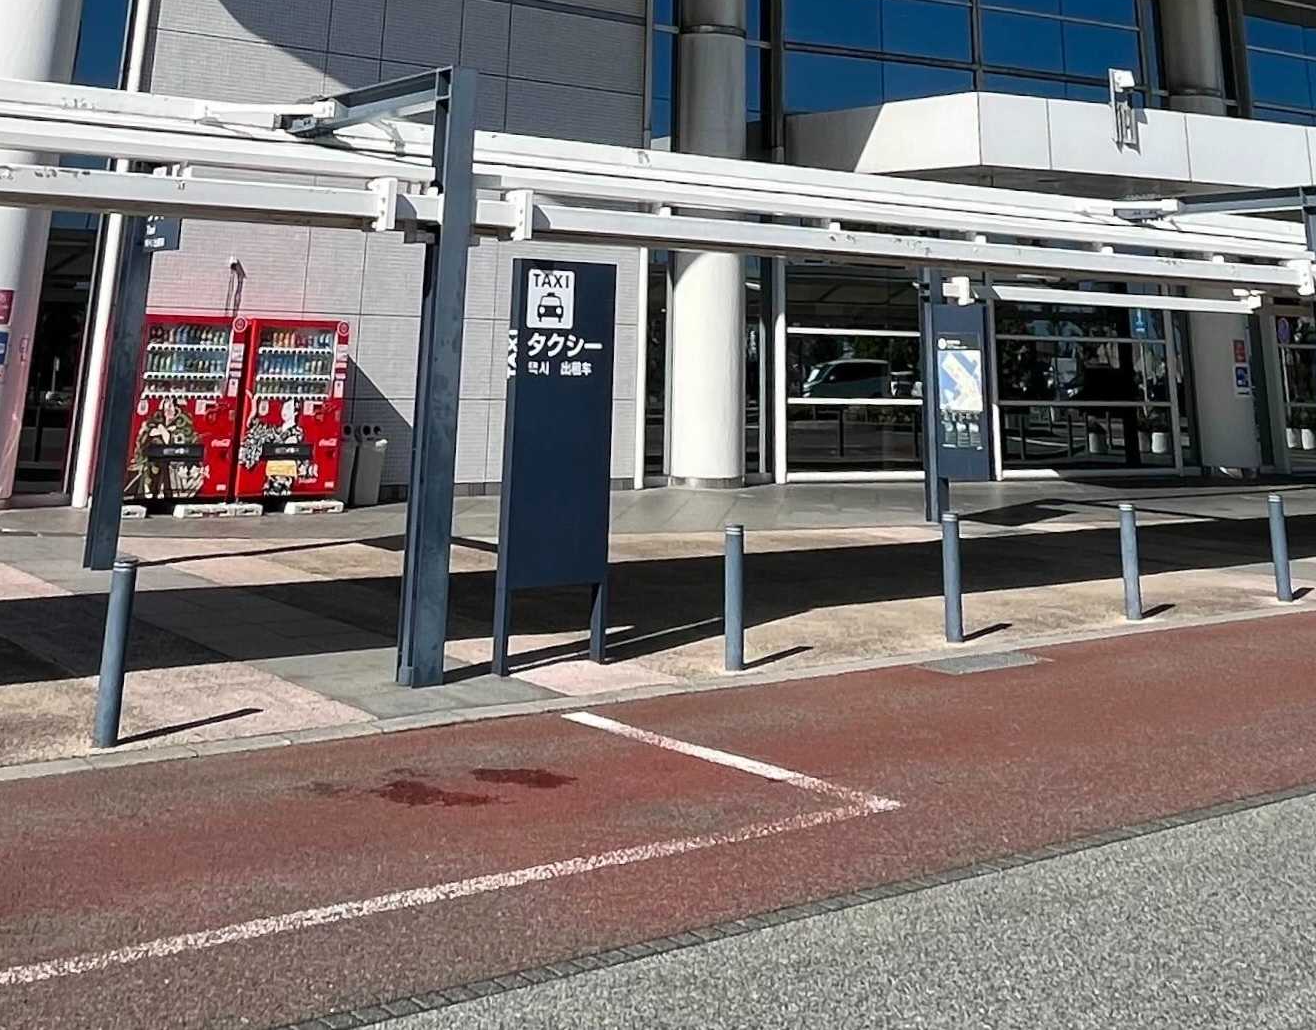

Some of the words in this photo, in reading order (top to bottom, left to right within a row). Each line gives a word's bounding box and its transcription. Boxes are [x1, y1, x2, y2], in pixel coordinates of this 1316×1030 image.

[533, 273, 570, 289] TAXI
[527, 332, 603, 358] タクシー
